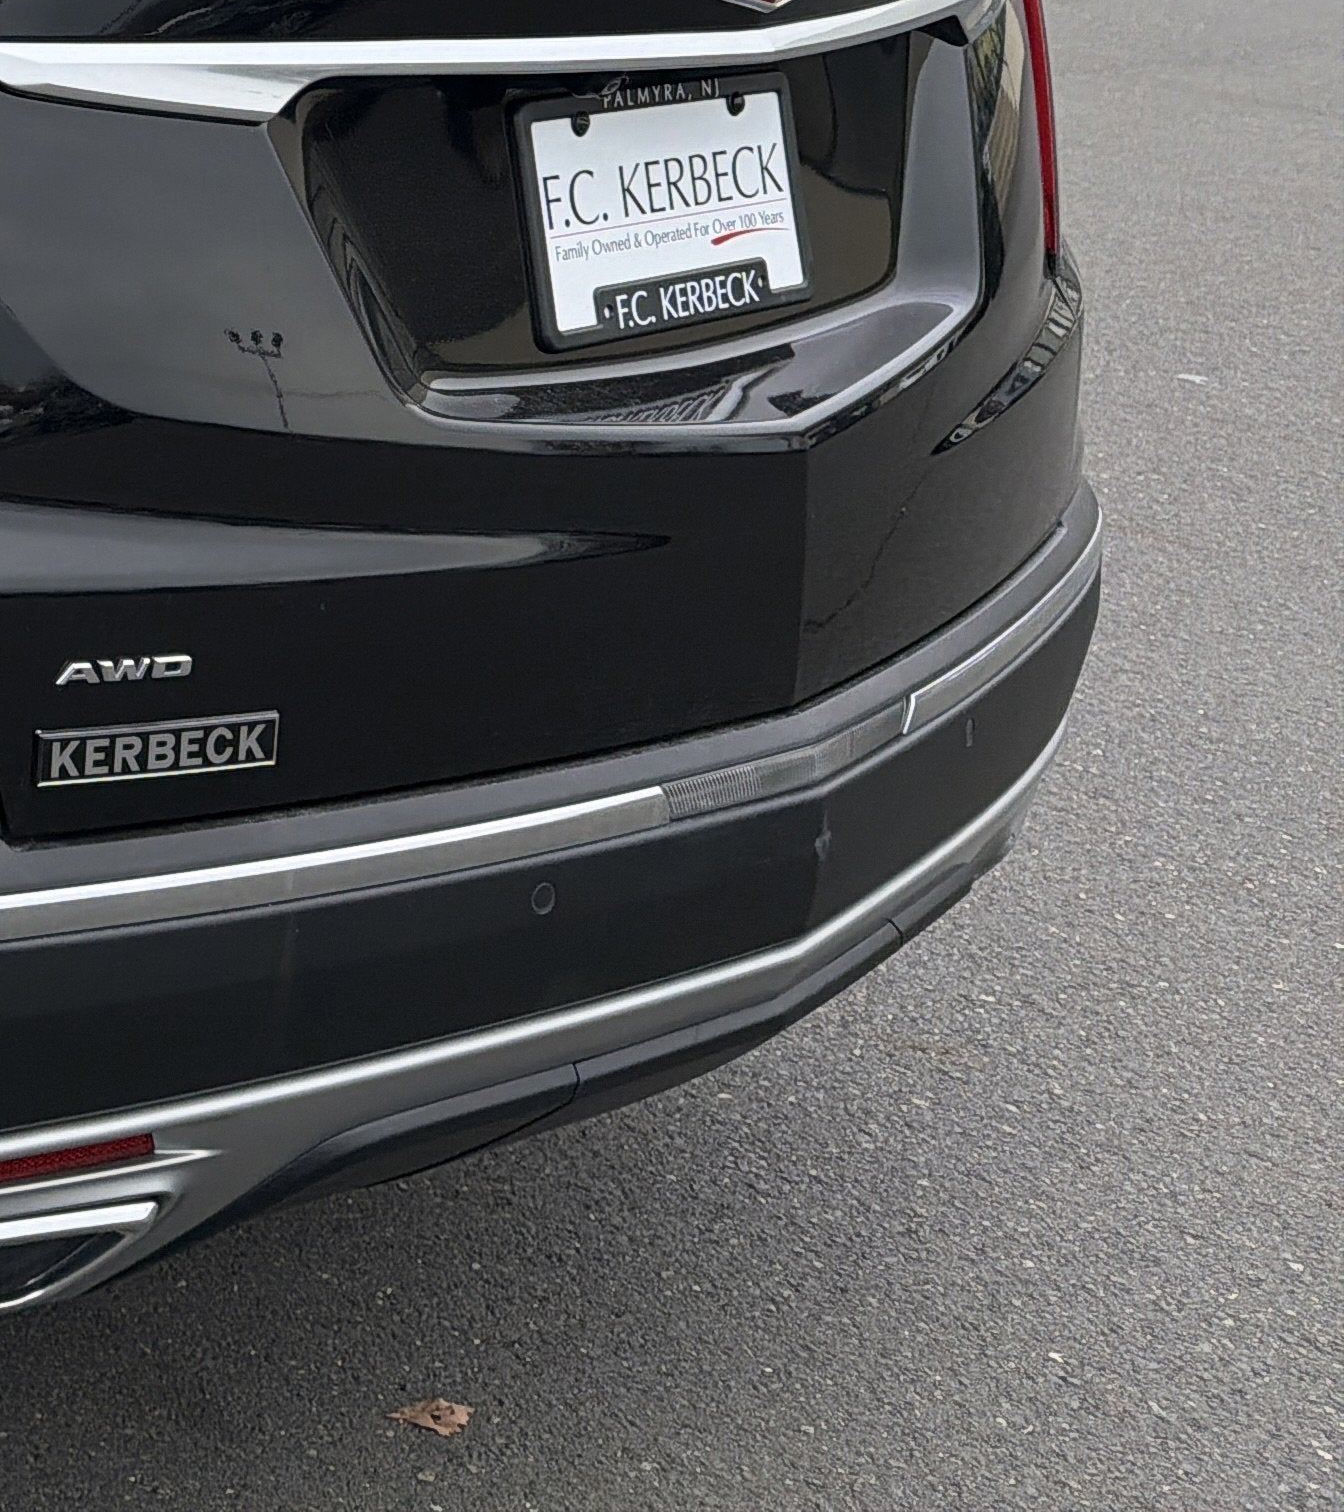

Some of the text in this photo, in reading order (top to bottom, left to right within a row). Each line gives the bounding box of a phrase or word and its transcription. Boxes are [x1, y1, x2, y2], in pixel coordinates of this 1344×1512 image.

[701, 78, 720, 98] NJ
[542, 142, 785, 230] F.C. KERBECK
[555, 210, 785, 262] Family Owned & Operated For Over 100 Years
[615, 269, 760, 330] F.C. KERBECK
[55, 654, 193, 685] AWD
[50, 723, 267, 779] KERBECK
